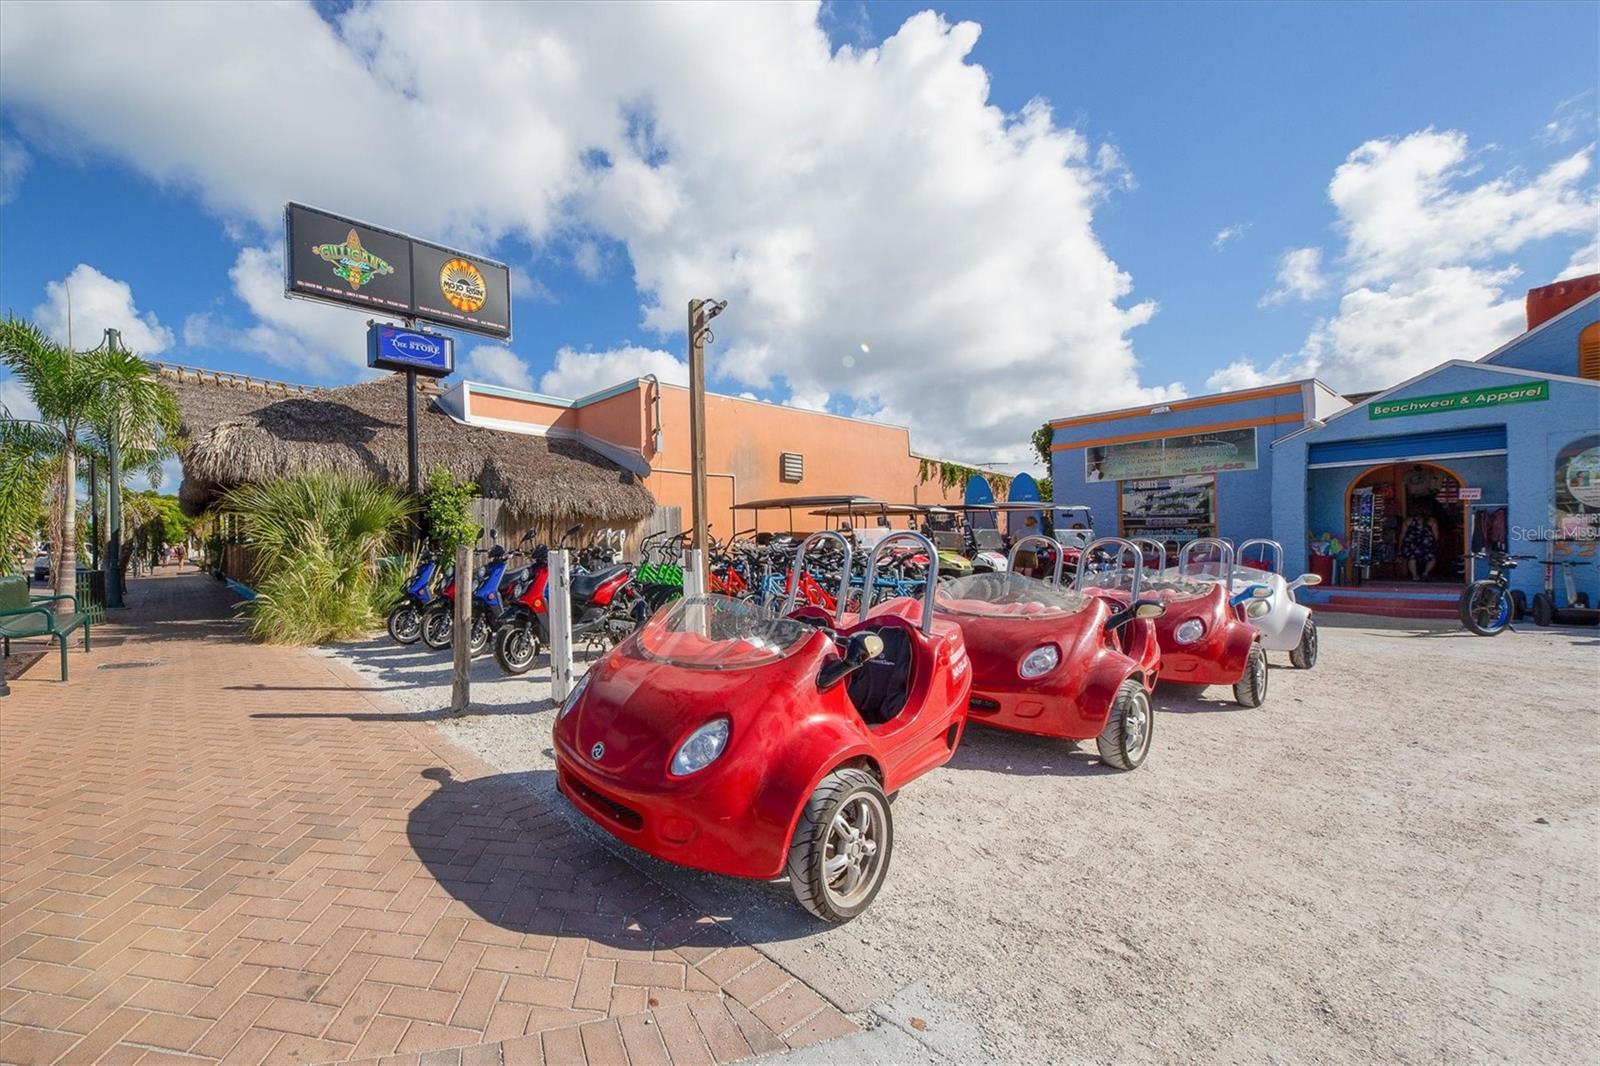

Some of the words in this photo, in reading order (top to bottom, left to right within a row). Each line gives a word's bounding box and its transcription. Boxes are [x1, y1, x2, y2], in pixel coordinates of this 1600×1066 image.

[443, 280, 464, 291] MOJO
[409, 341, 440, 354] STORE
[1374, 399, 1455, 415] Beachwear
[1460, 396, 1470, 405] &
[1475, 386, 1542, 403] Apparel
